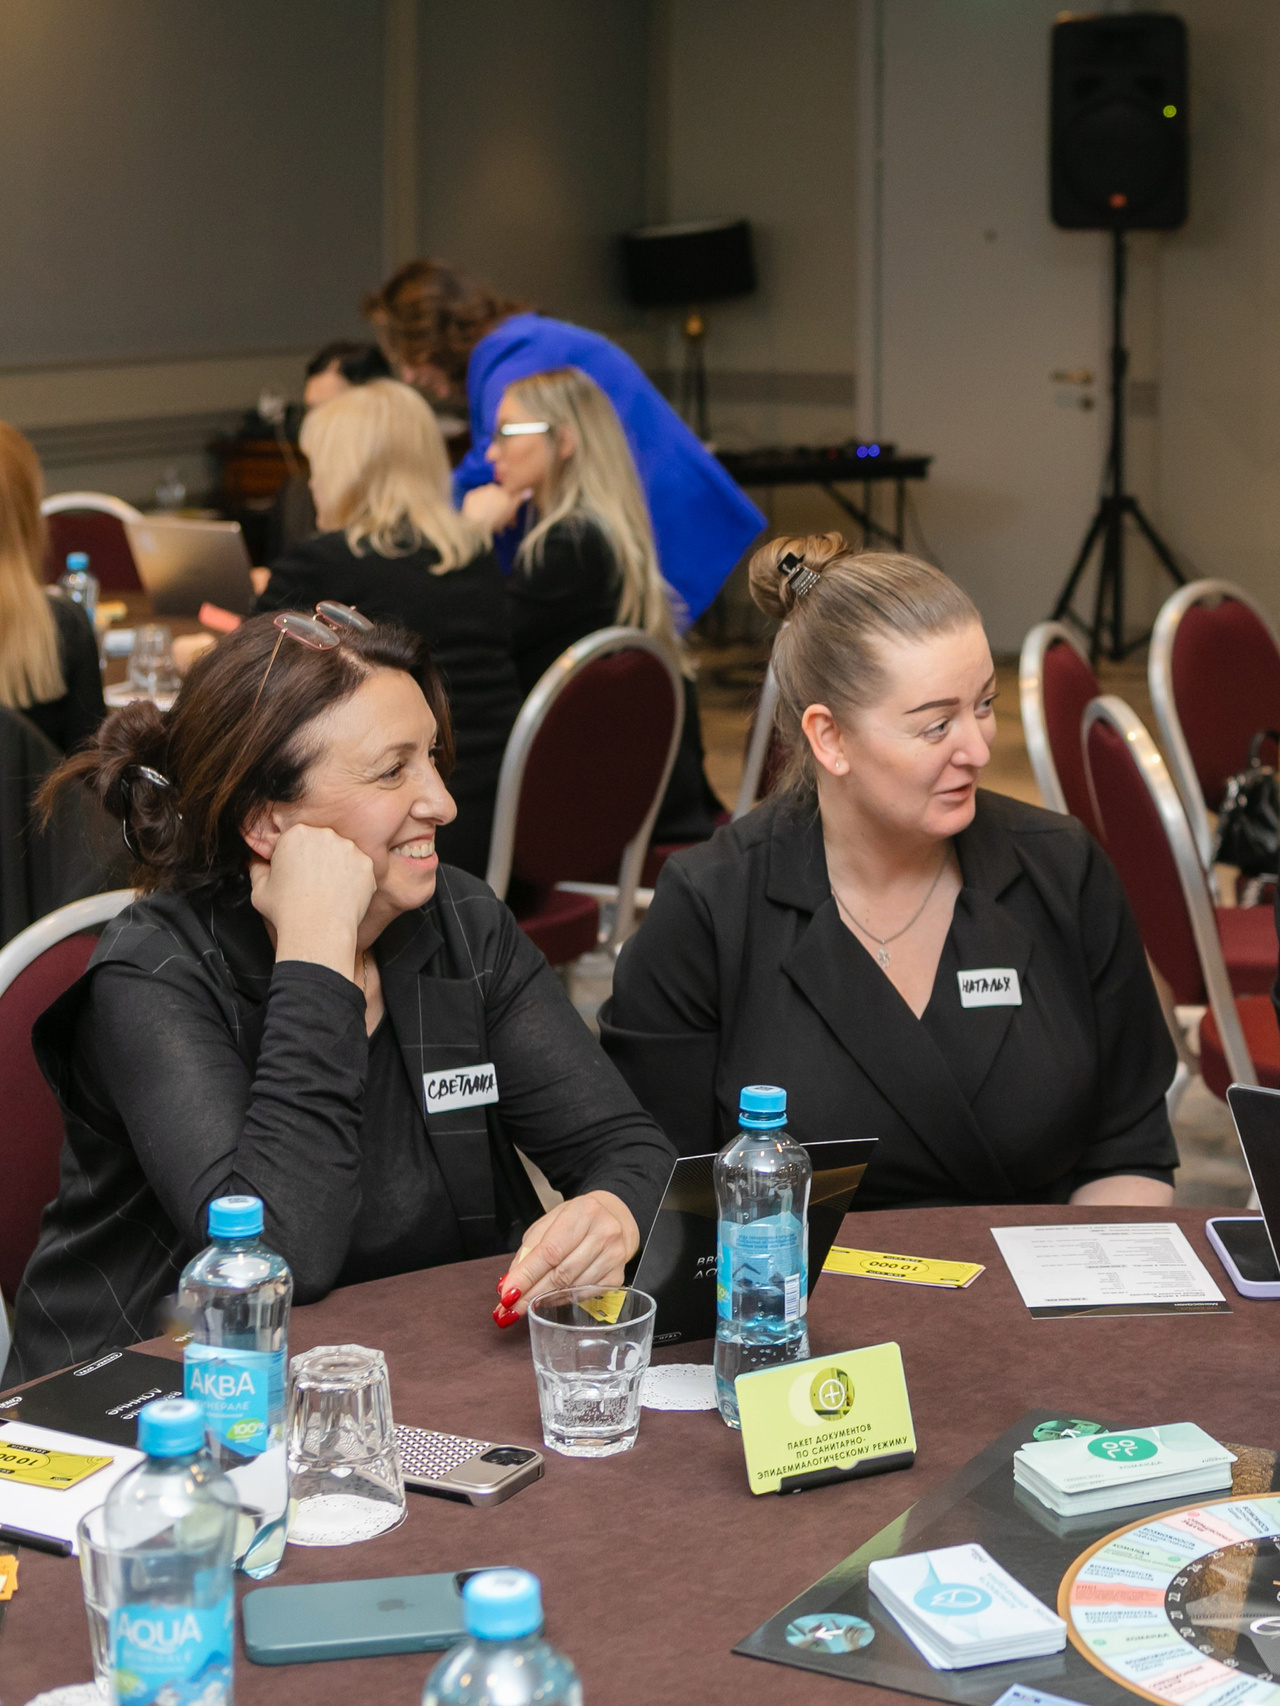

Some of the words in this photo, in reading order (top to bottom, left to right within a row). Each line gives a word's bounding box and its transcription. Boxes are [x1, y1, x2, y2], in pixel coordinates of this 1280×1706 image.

[869, 1261, 898, 1269] 000
[189, 1368, 255, 1400] АКВА
[787, 1438, 813, 1450] ПАКЕТ
[816, 1423, 872, 1444] ДОКУМЕНТОВ
[796, 1447, 809, 1459] ПО
[812, 1438, 866, 1456] САНИТАРНО-
[16, 1457, 38, 1465] 10
[757, 1447, 870, 1480] ЭПИДЕМИАЛОГИЧЕСКОМУ
[873, 1436, 908, 1452] РЕЖИМУ
[117, 1613, 202, 1654] AQUA
